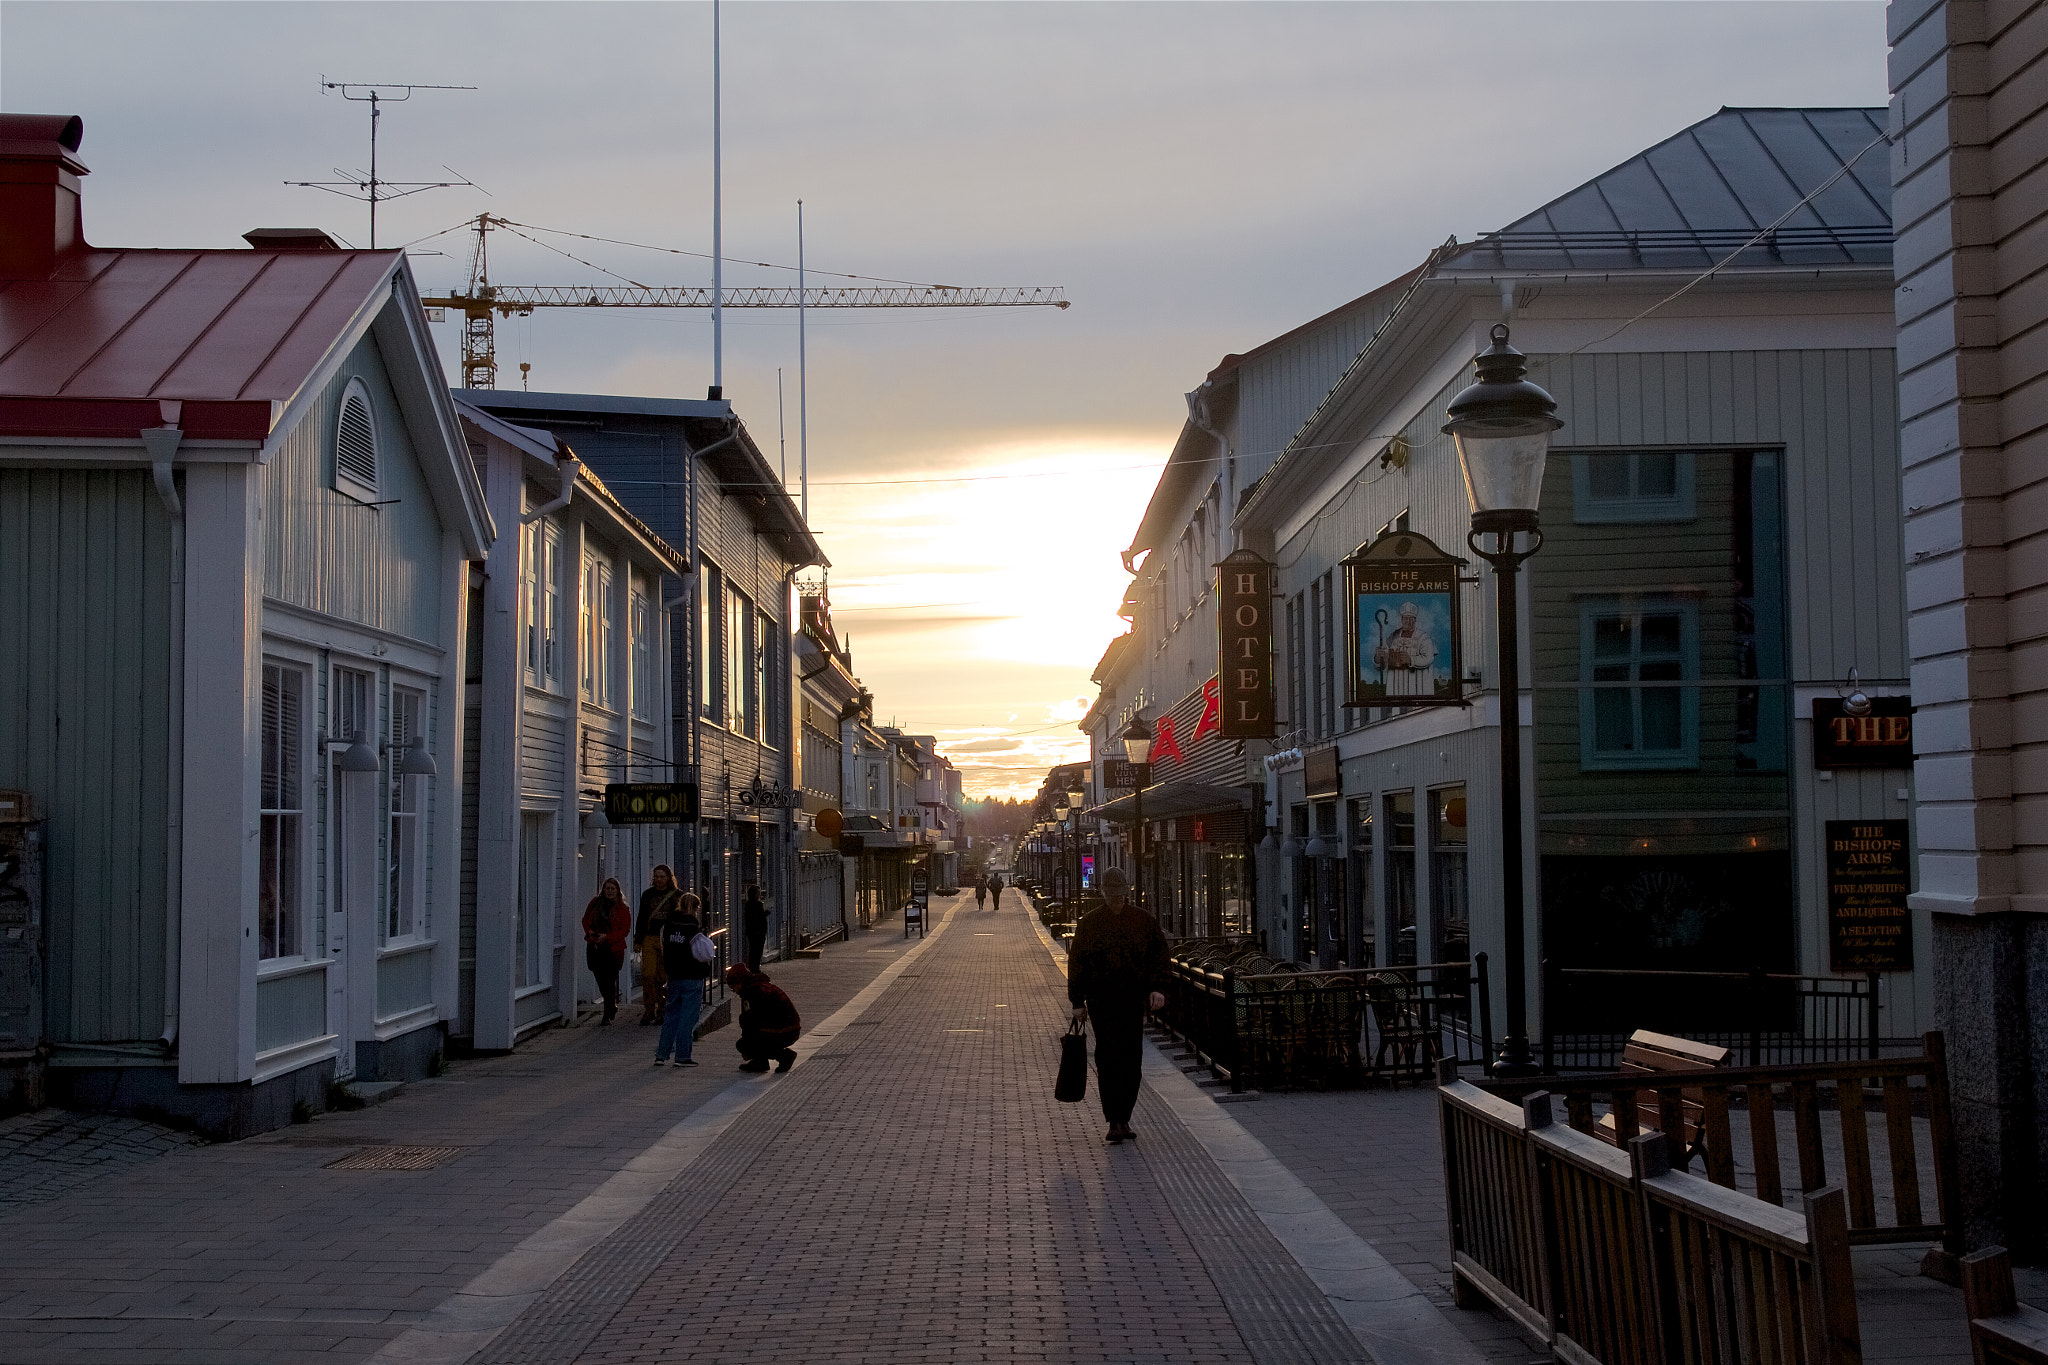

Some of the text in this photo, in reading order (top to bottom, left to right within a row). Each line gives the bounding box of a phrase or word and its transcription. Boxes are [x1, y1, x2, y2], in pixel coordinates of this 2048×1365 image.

[1391, 571, 1419, 580] THE
[1361, 581, 1449, 591] BISHOPS ARMS
[1234, 573, 1260, 722] HOTEL
[1831, 716, 1911, 745] THE
[612, 791, 690, 814] KROKODIL
[1851, 826, 1884, 838] THE
[1833, 839, 1902, 852] BISHOPS
[1846, 852, 1892, 865] ARMS
[1834, 883, 1906, 894] FINE APERITIFS
[1836, 907, 1906, 918] AND LIQUEURS
[1838, 926, 1902, 936] A SELECTION
